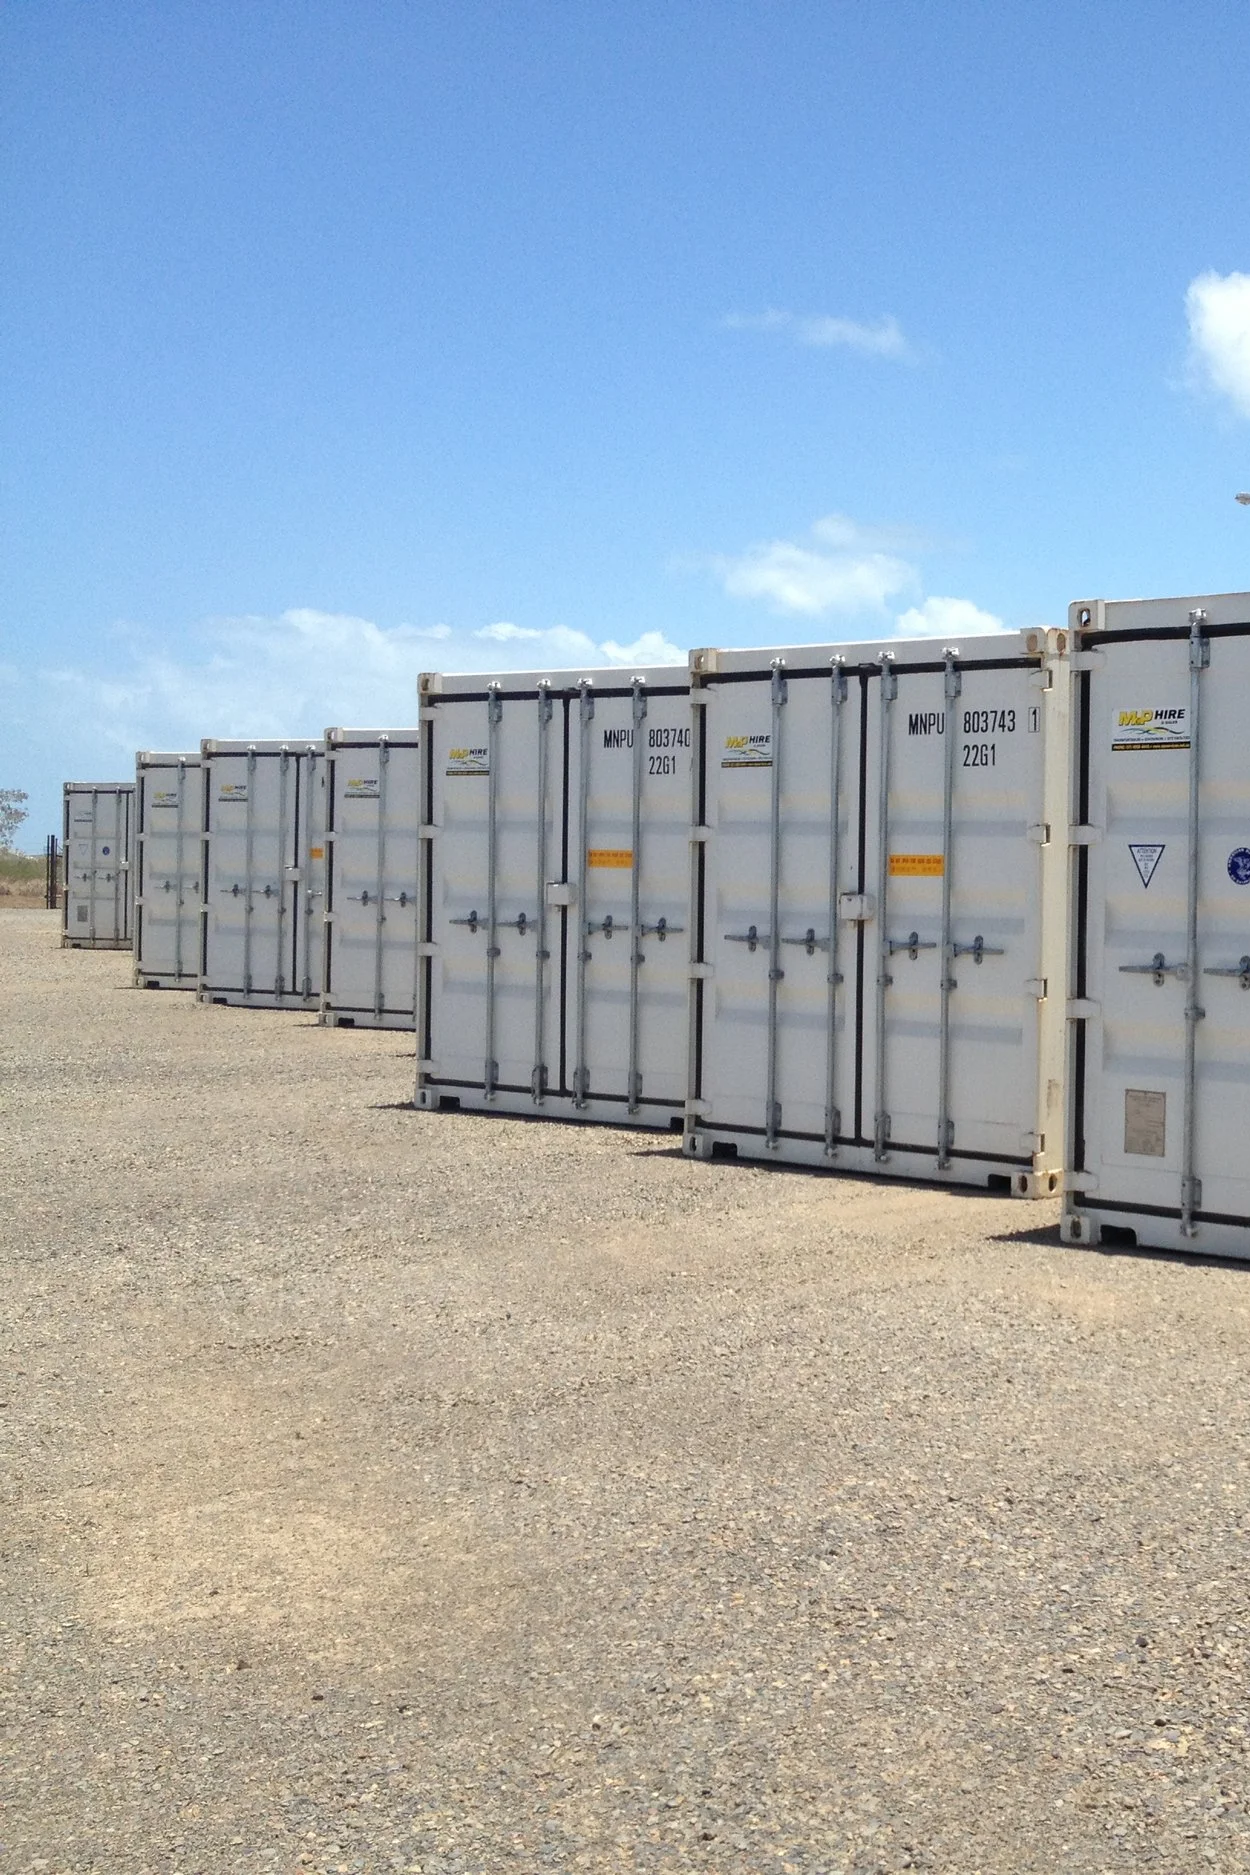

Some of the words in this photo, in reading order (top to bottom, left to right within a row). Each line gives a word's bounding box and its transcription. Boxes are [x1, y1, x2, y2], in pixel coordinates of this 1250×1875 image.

[908, 712, 945, 736] MNPU
[963, 709, 1016, 734] 803743
[1154, 708, 1186, 720] HIRE
[603, 729, 634, 749] MNPU
[749, 735, 771, 743] HIRE
[648, 755, 676, 775] 22G1
[962, 743, 996, 767] 22G1
